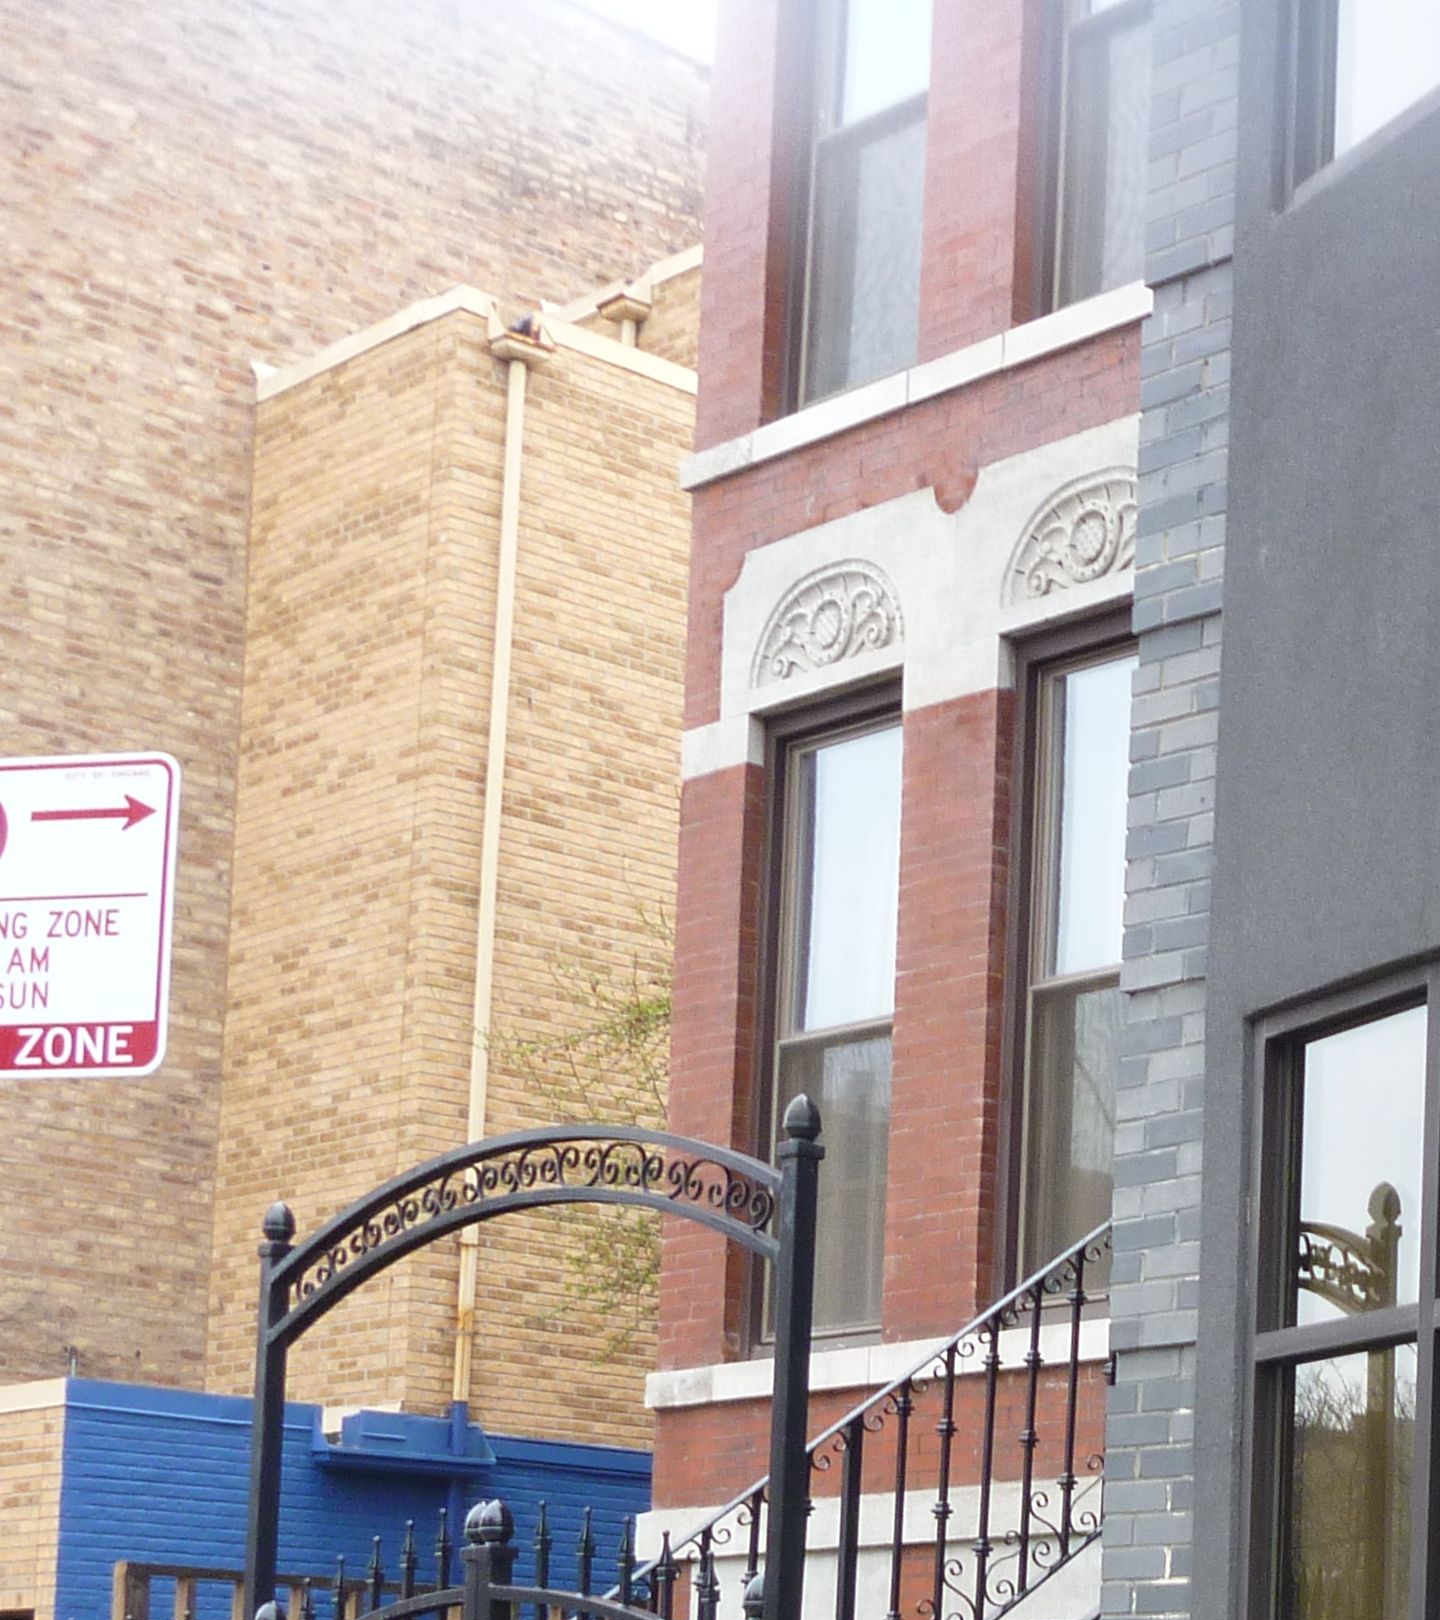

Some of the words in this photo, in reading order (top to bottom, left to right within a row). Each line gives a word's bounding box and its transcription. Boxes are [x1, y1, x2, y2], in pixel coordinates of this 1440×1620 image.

[46, 909, 120, 938] ZONE
[6, 946, 50, 974] AM
[14, 1025, 134, 1066] ZONE
